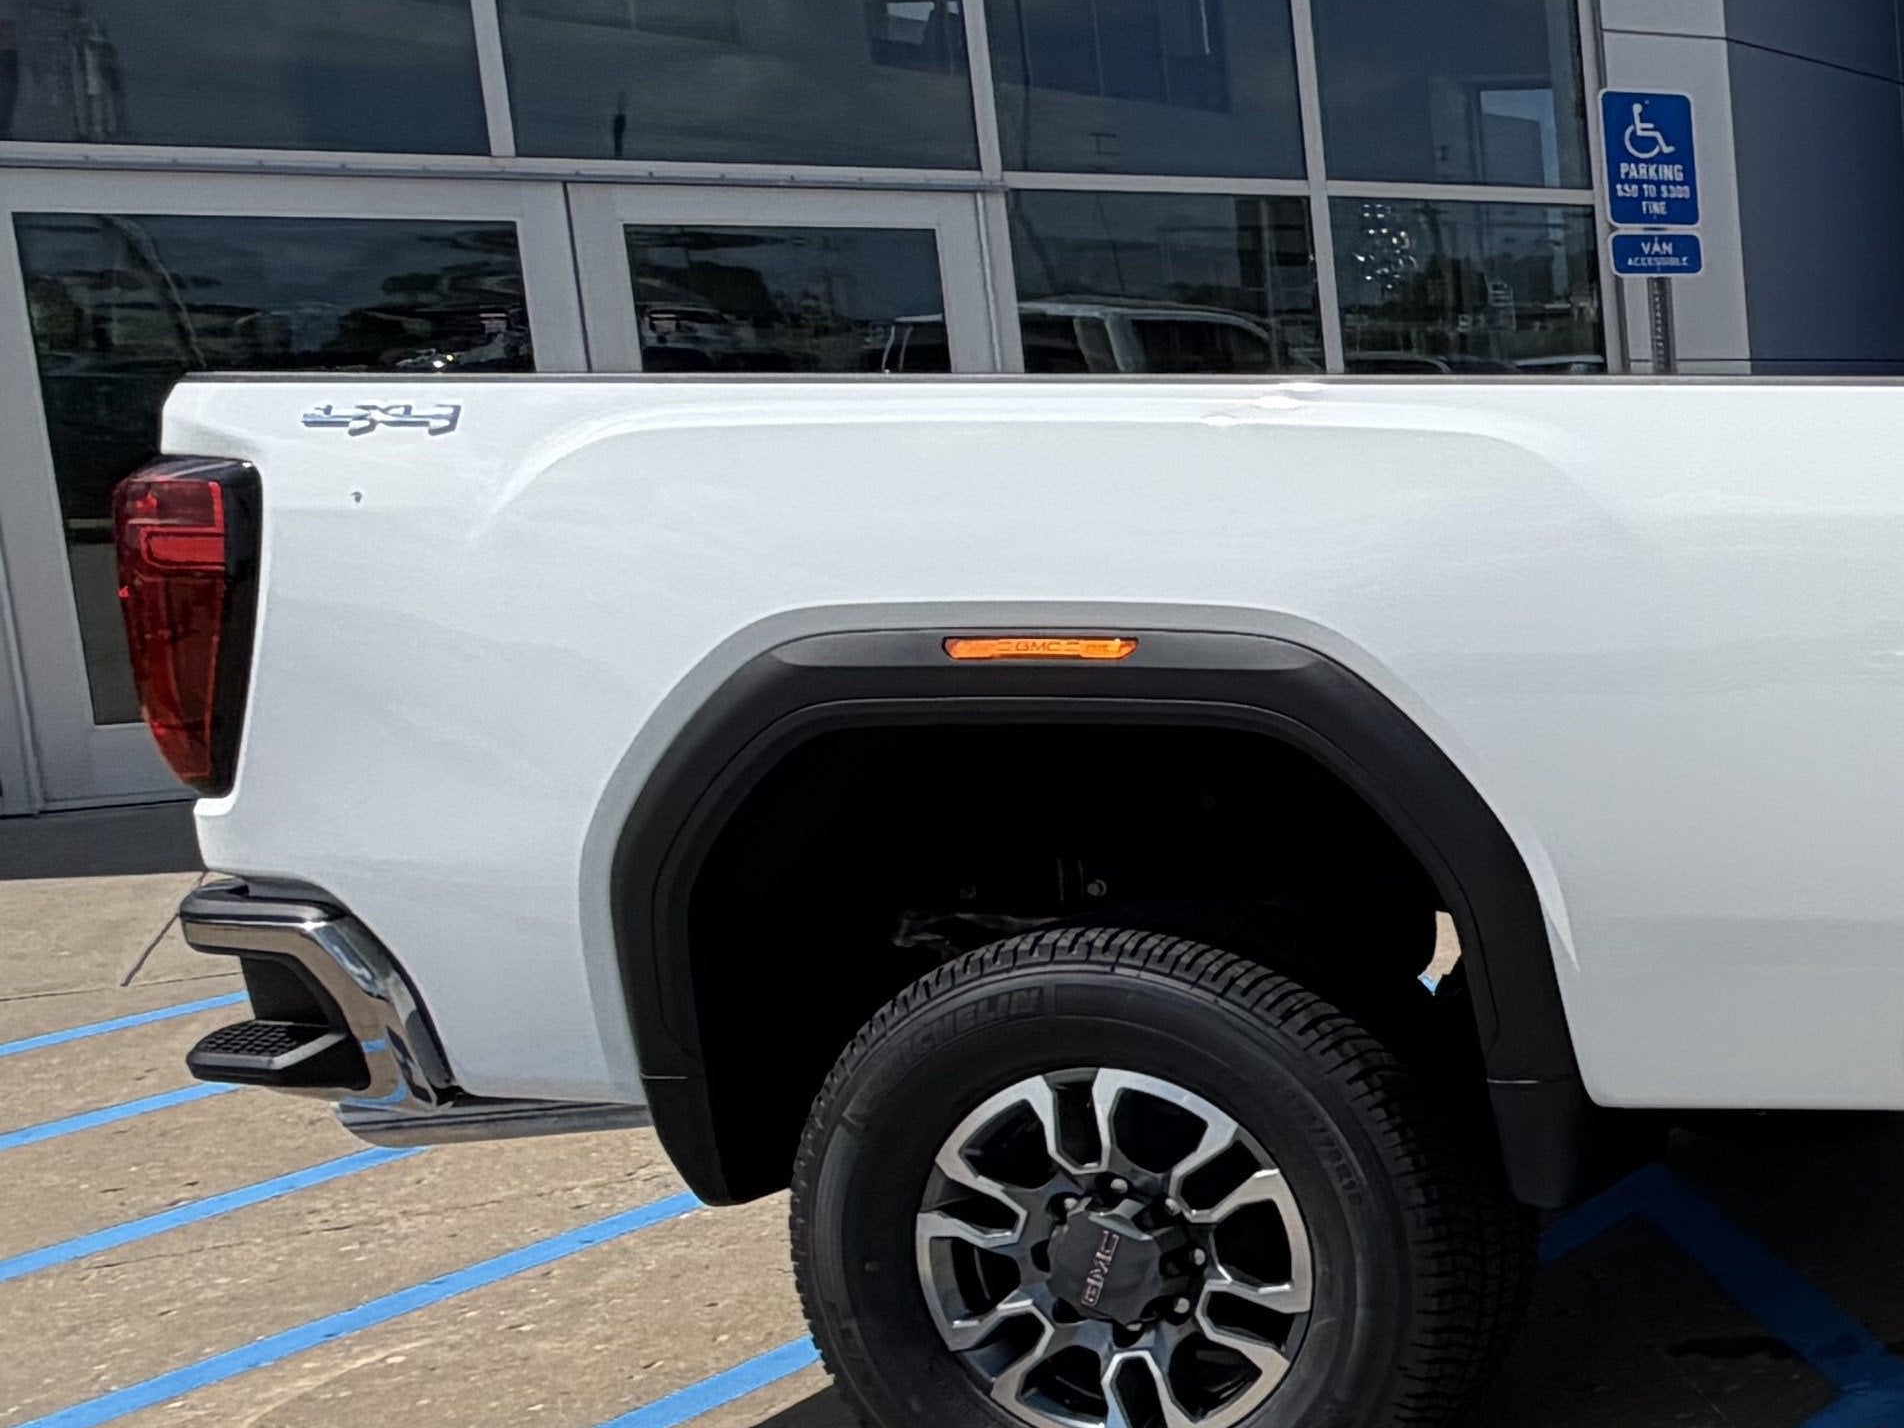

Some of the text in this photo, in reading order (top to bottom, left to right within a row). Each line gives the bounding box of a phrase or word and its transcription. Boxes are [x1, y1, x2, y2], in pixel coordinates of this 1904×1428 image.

[1620, 163, 1684, 181] PARKING
[1616, 184, 1639, 198] $50
[1643, 184, 1657, 198] TO
[1642, 201, 1668, 215] FINE
[1641, 241, 1673, 255] VAN
[1081, 1230, 1120, 1307] GMC
